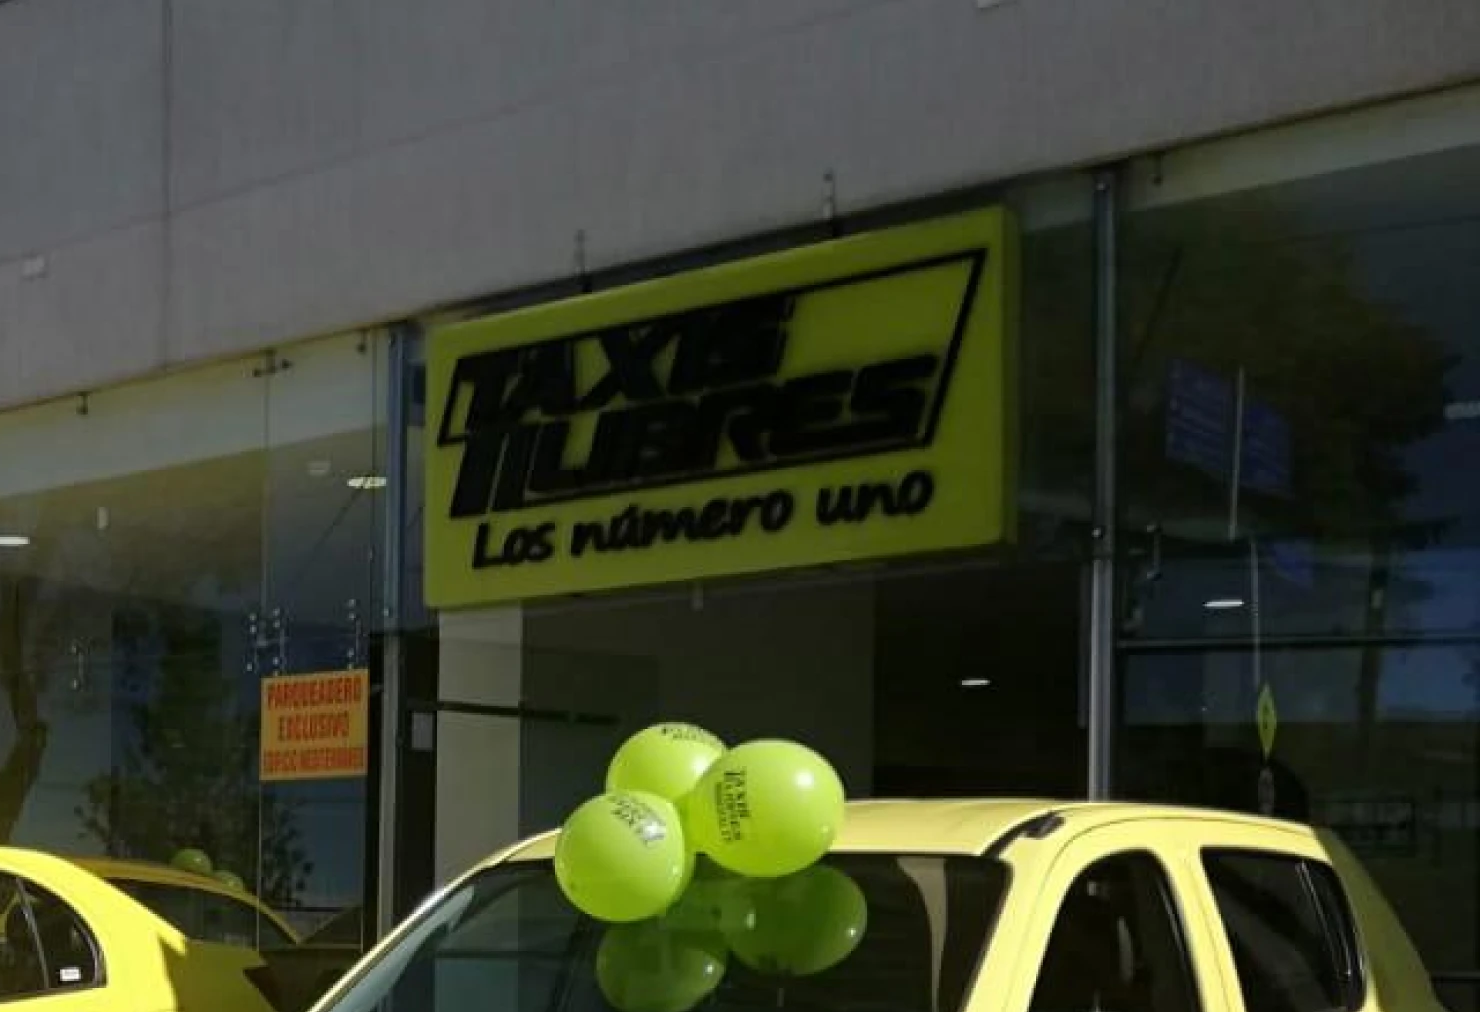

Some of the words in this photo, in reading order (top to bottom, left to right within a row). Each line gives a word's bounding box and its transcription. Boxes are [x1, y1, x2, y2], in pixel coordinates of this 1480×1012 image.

[452, 294, 796, 470] TAXIS
[525, 355, 939, 493] LIBRES
[472, 521, 556, 570] Los
[569, 489, 794, 558] número
[815, 469, 936, 526] uno
